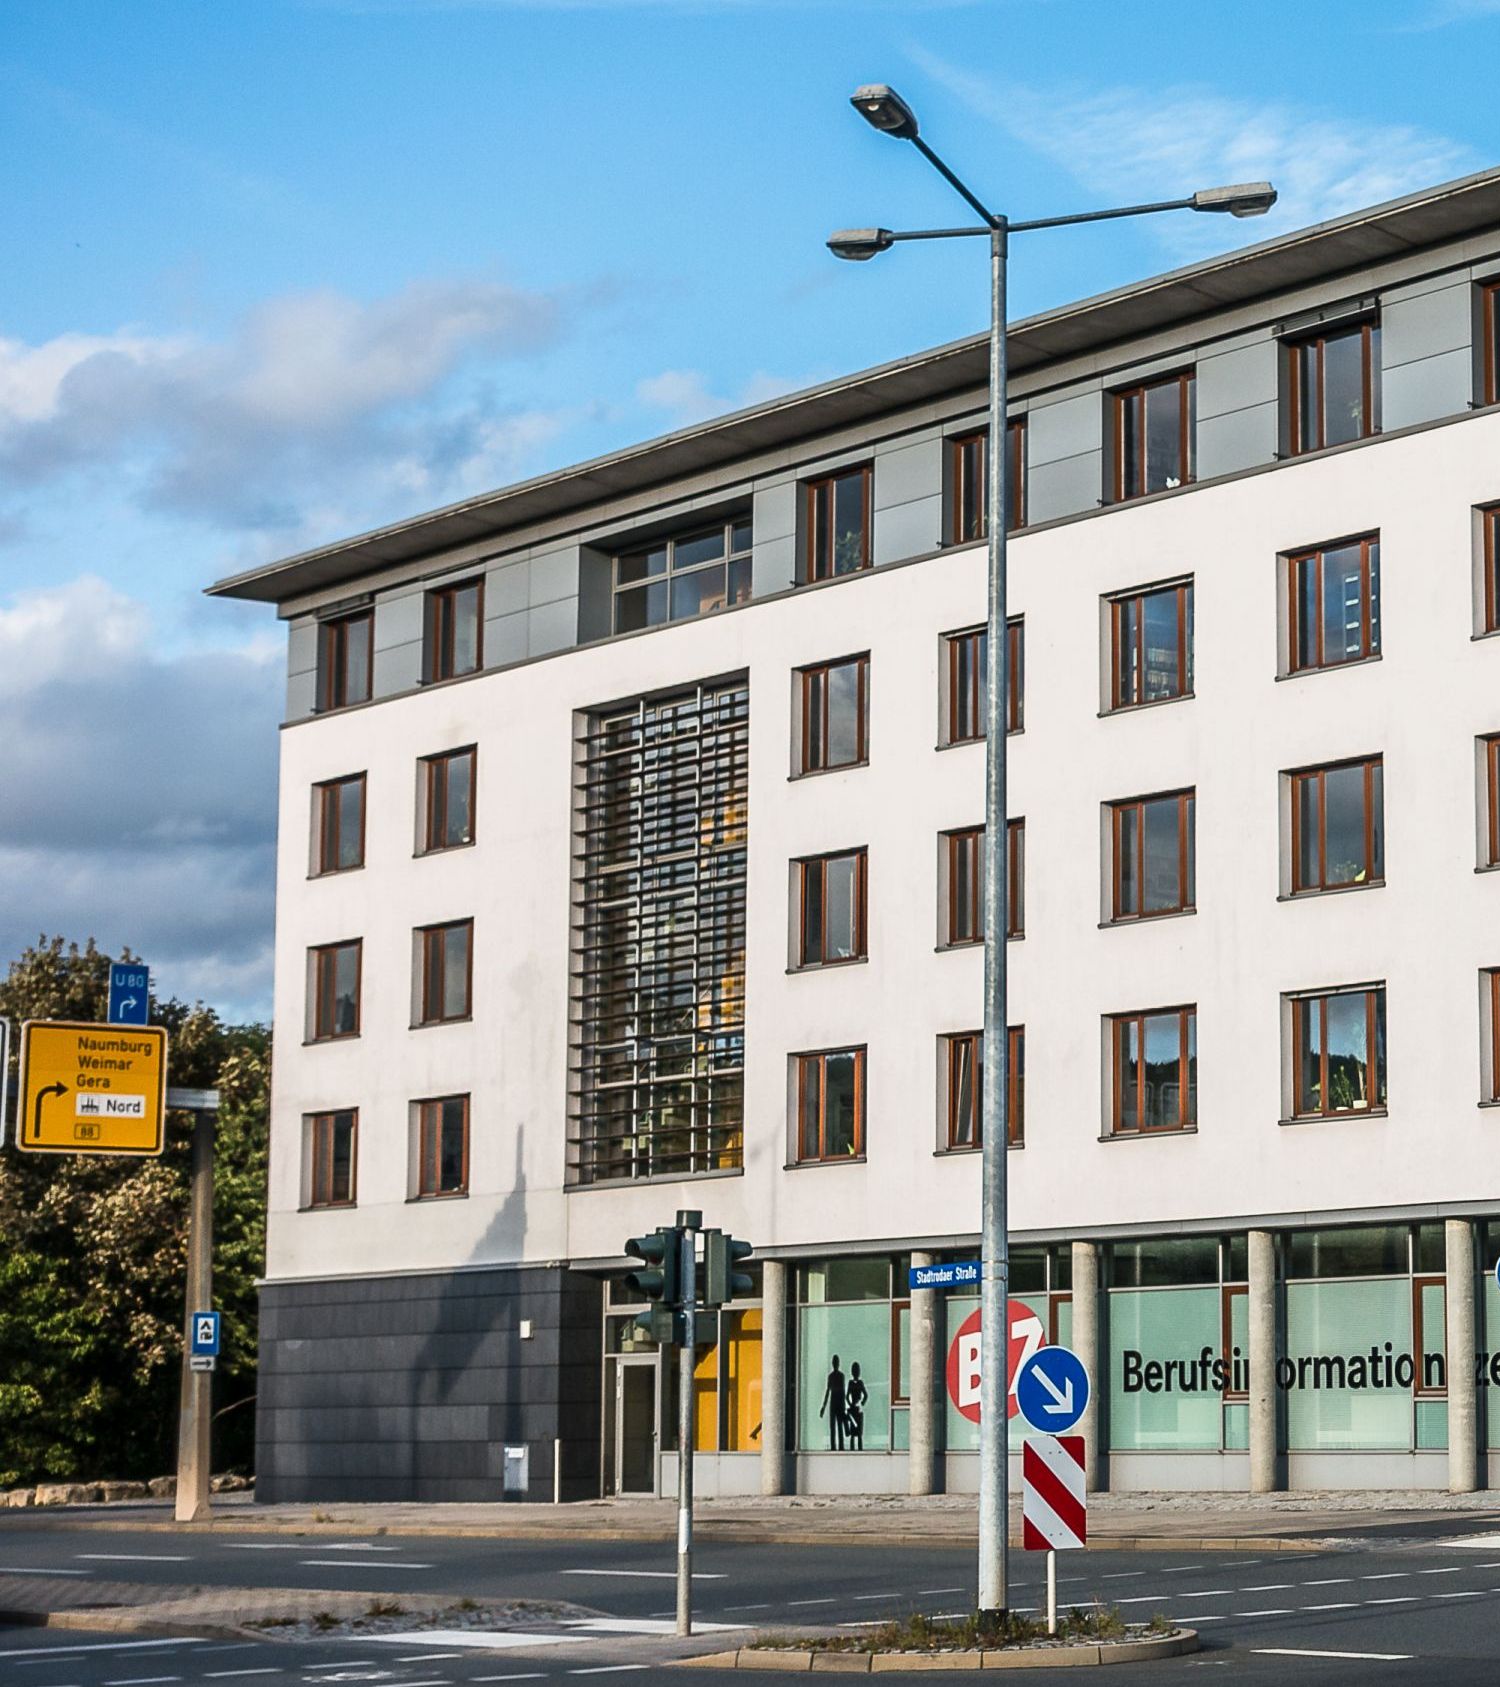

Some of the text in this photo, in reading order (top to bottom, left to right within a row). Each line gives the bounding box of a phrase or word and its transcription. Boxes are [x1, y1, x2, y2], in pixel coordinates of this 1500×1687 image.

[78, 1036, 153, 1056] Naumburg
[78, 1055, 134, 1071] Weimar
[76, 1073, 111, 1089] Gera
[106, 1099, 141, 1114] Nord
[80, 1126, 94, 1138] 88
[916, 1265, 977, 1285] Stadtrodaer Straße
[958, 1315, 1044, 1408] BZ
